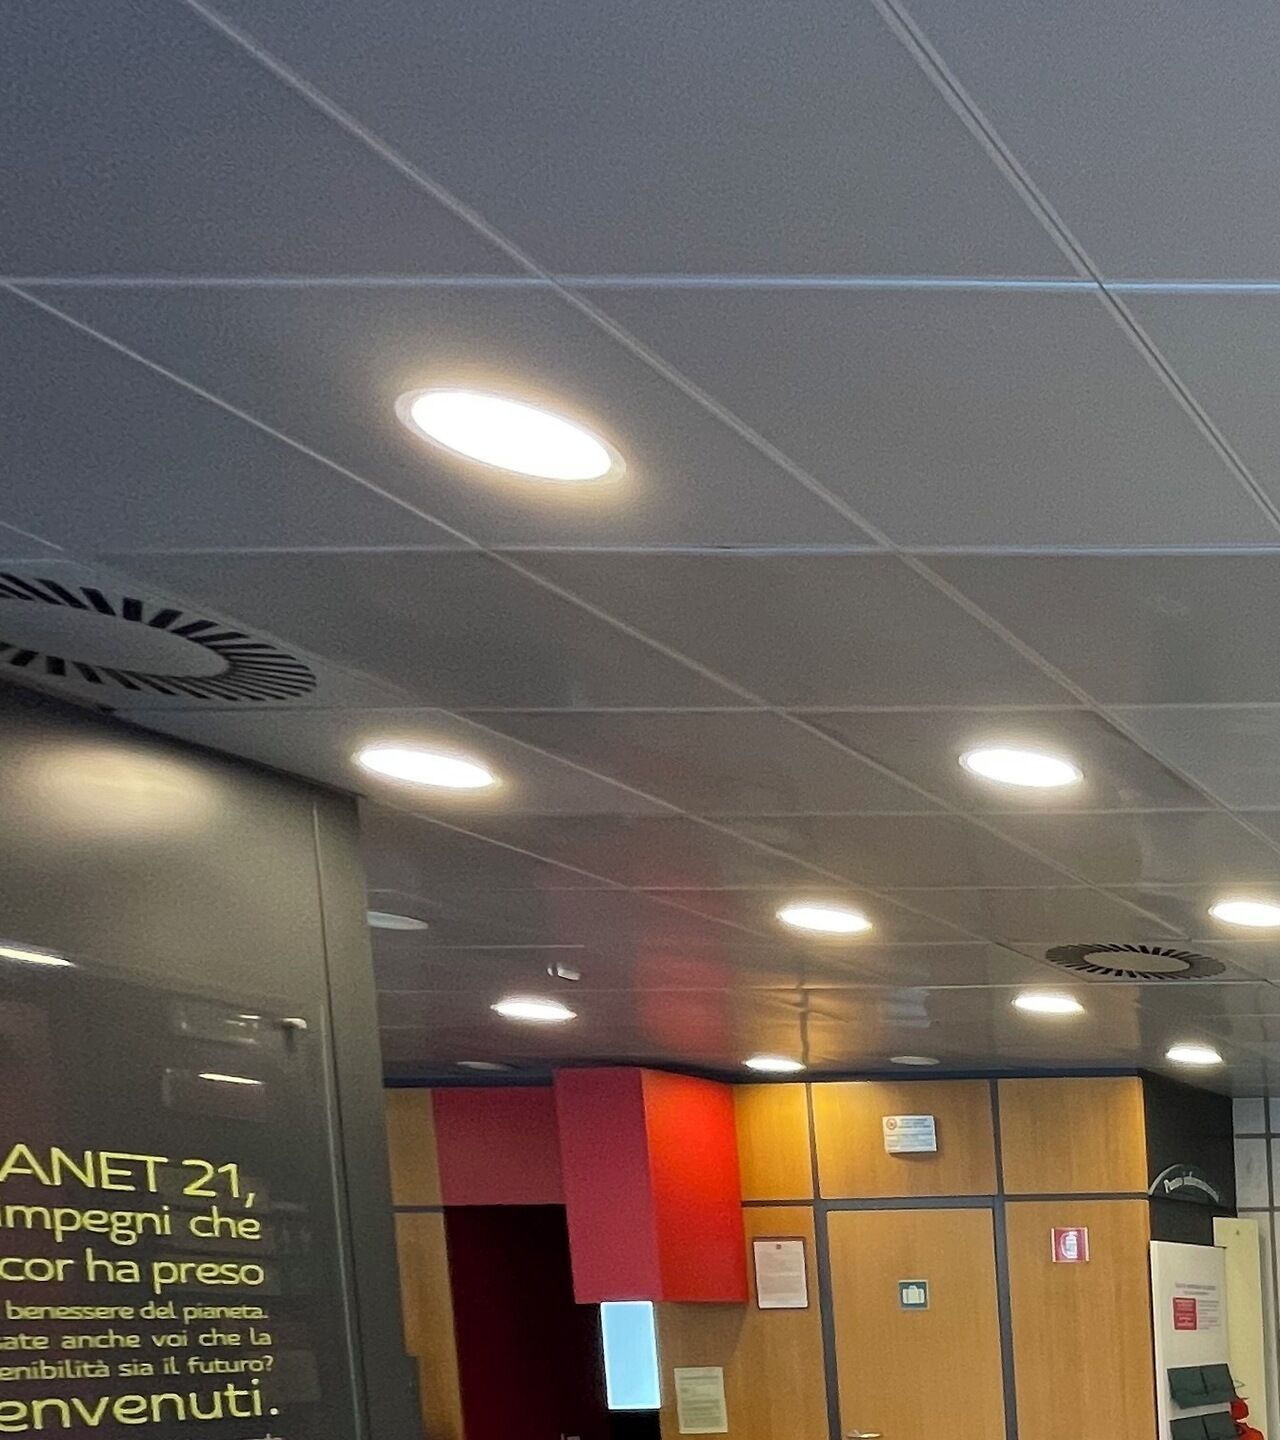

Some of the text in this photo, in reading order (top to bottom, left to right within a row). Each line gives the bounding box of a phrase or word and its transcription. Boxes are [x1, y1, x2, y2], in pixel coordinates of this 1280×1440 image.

[182, 1158, 256, 1208] 21,
[0, 1204, 262, 1246] mpegni che
[0, 1247, 265, 1295] cor ha preso
[5, 1300, 269, 1325] benessere del pianeta.
[61, 1328, 142, 1350] anche
[151, 1329, 188, 1347] voi
[198, 1327, 242, 1347] che
[249, 1326, 273, 1346] la
[118, 1358, 154, 1378] sia
[162, 1356, 181, 1375] il
[187, 1354, 275, 1374] futuro?
